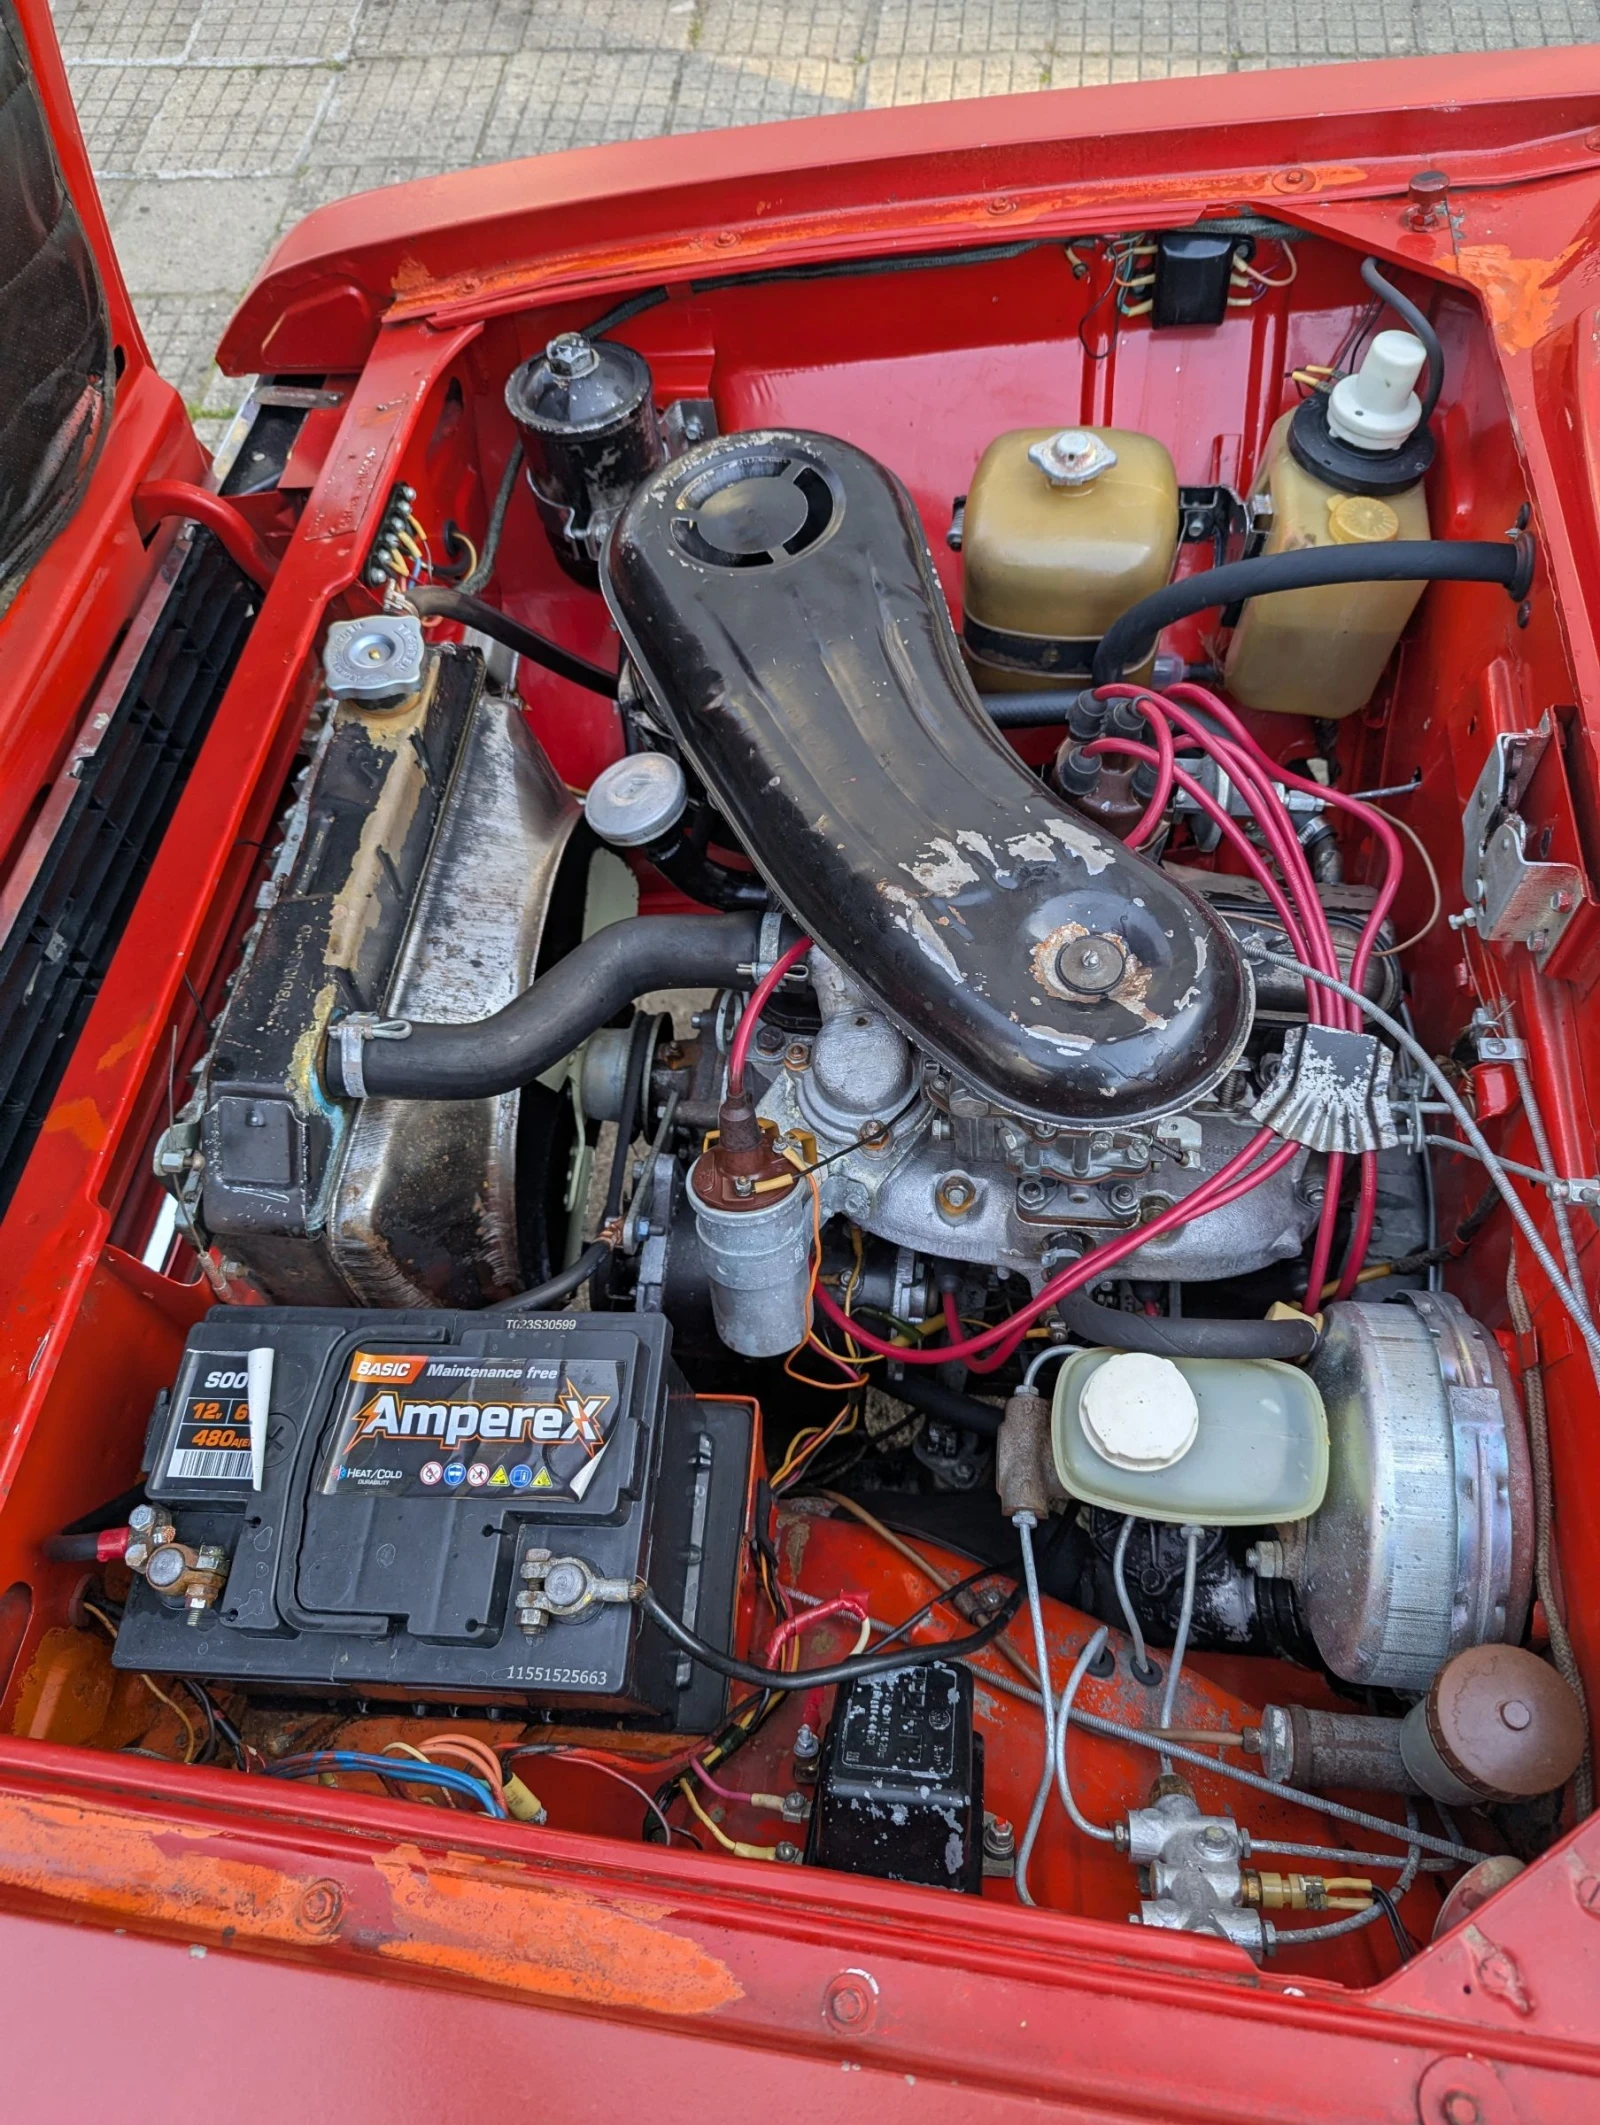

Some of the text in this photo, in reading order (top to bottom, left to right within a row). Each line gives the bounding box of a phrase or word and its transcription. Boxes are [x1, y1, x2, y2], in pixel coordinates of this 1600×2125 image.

[356, 1360, 410, 1377] BASIC
[426, 1363, 558, 1380] Maintenance free
[360, 1392, 603, 1446] AmpereX
[357, 1478, 390, 1486] DURABILITY
[506, 1664, 608, 1686] 11551525663
